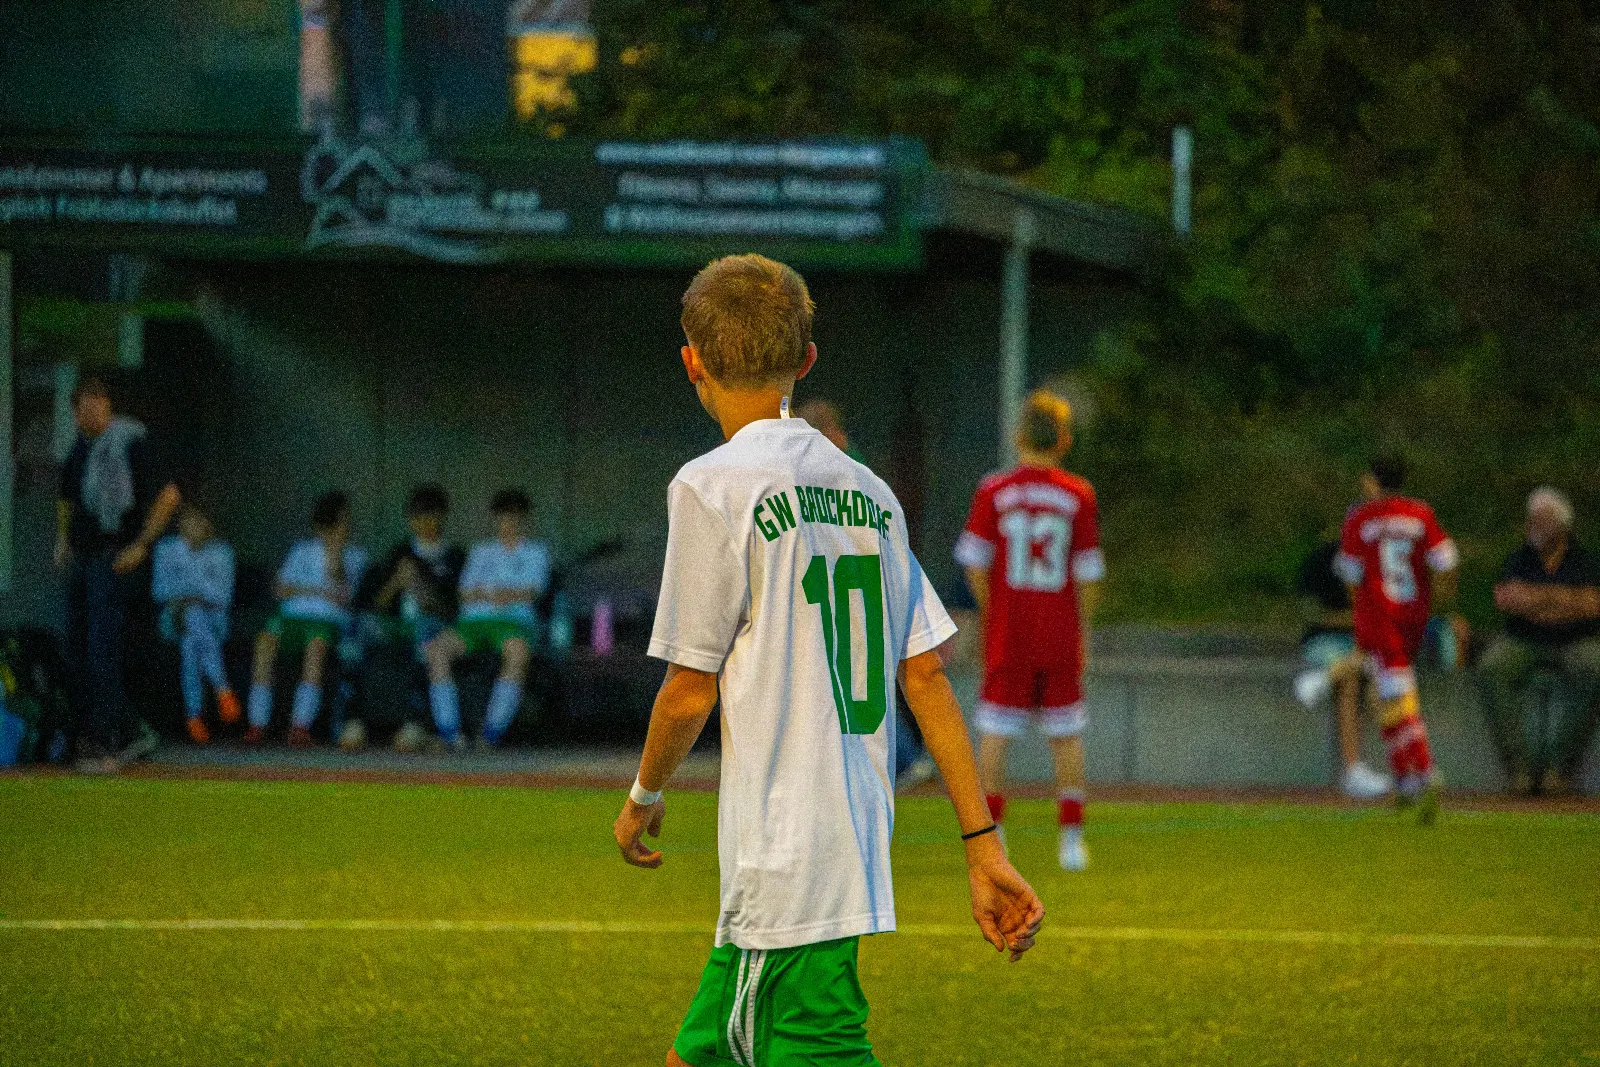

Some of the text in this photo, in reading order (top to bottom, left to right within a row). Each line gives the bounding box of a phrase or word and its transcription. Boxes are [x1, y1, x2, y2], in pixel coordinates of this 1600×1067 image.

[753, 485, 893, 543] GW BROCKDORF
[999, 510, 1071, 592] 13
[801, 554, 887, 735] 10
